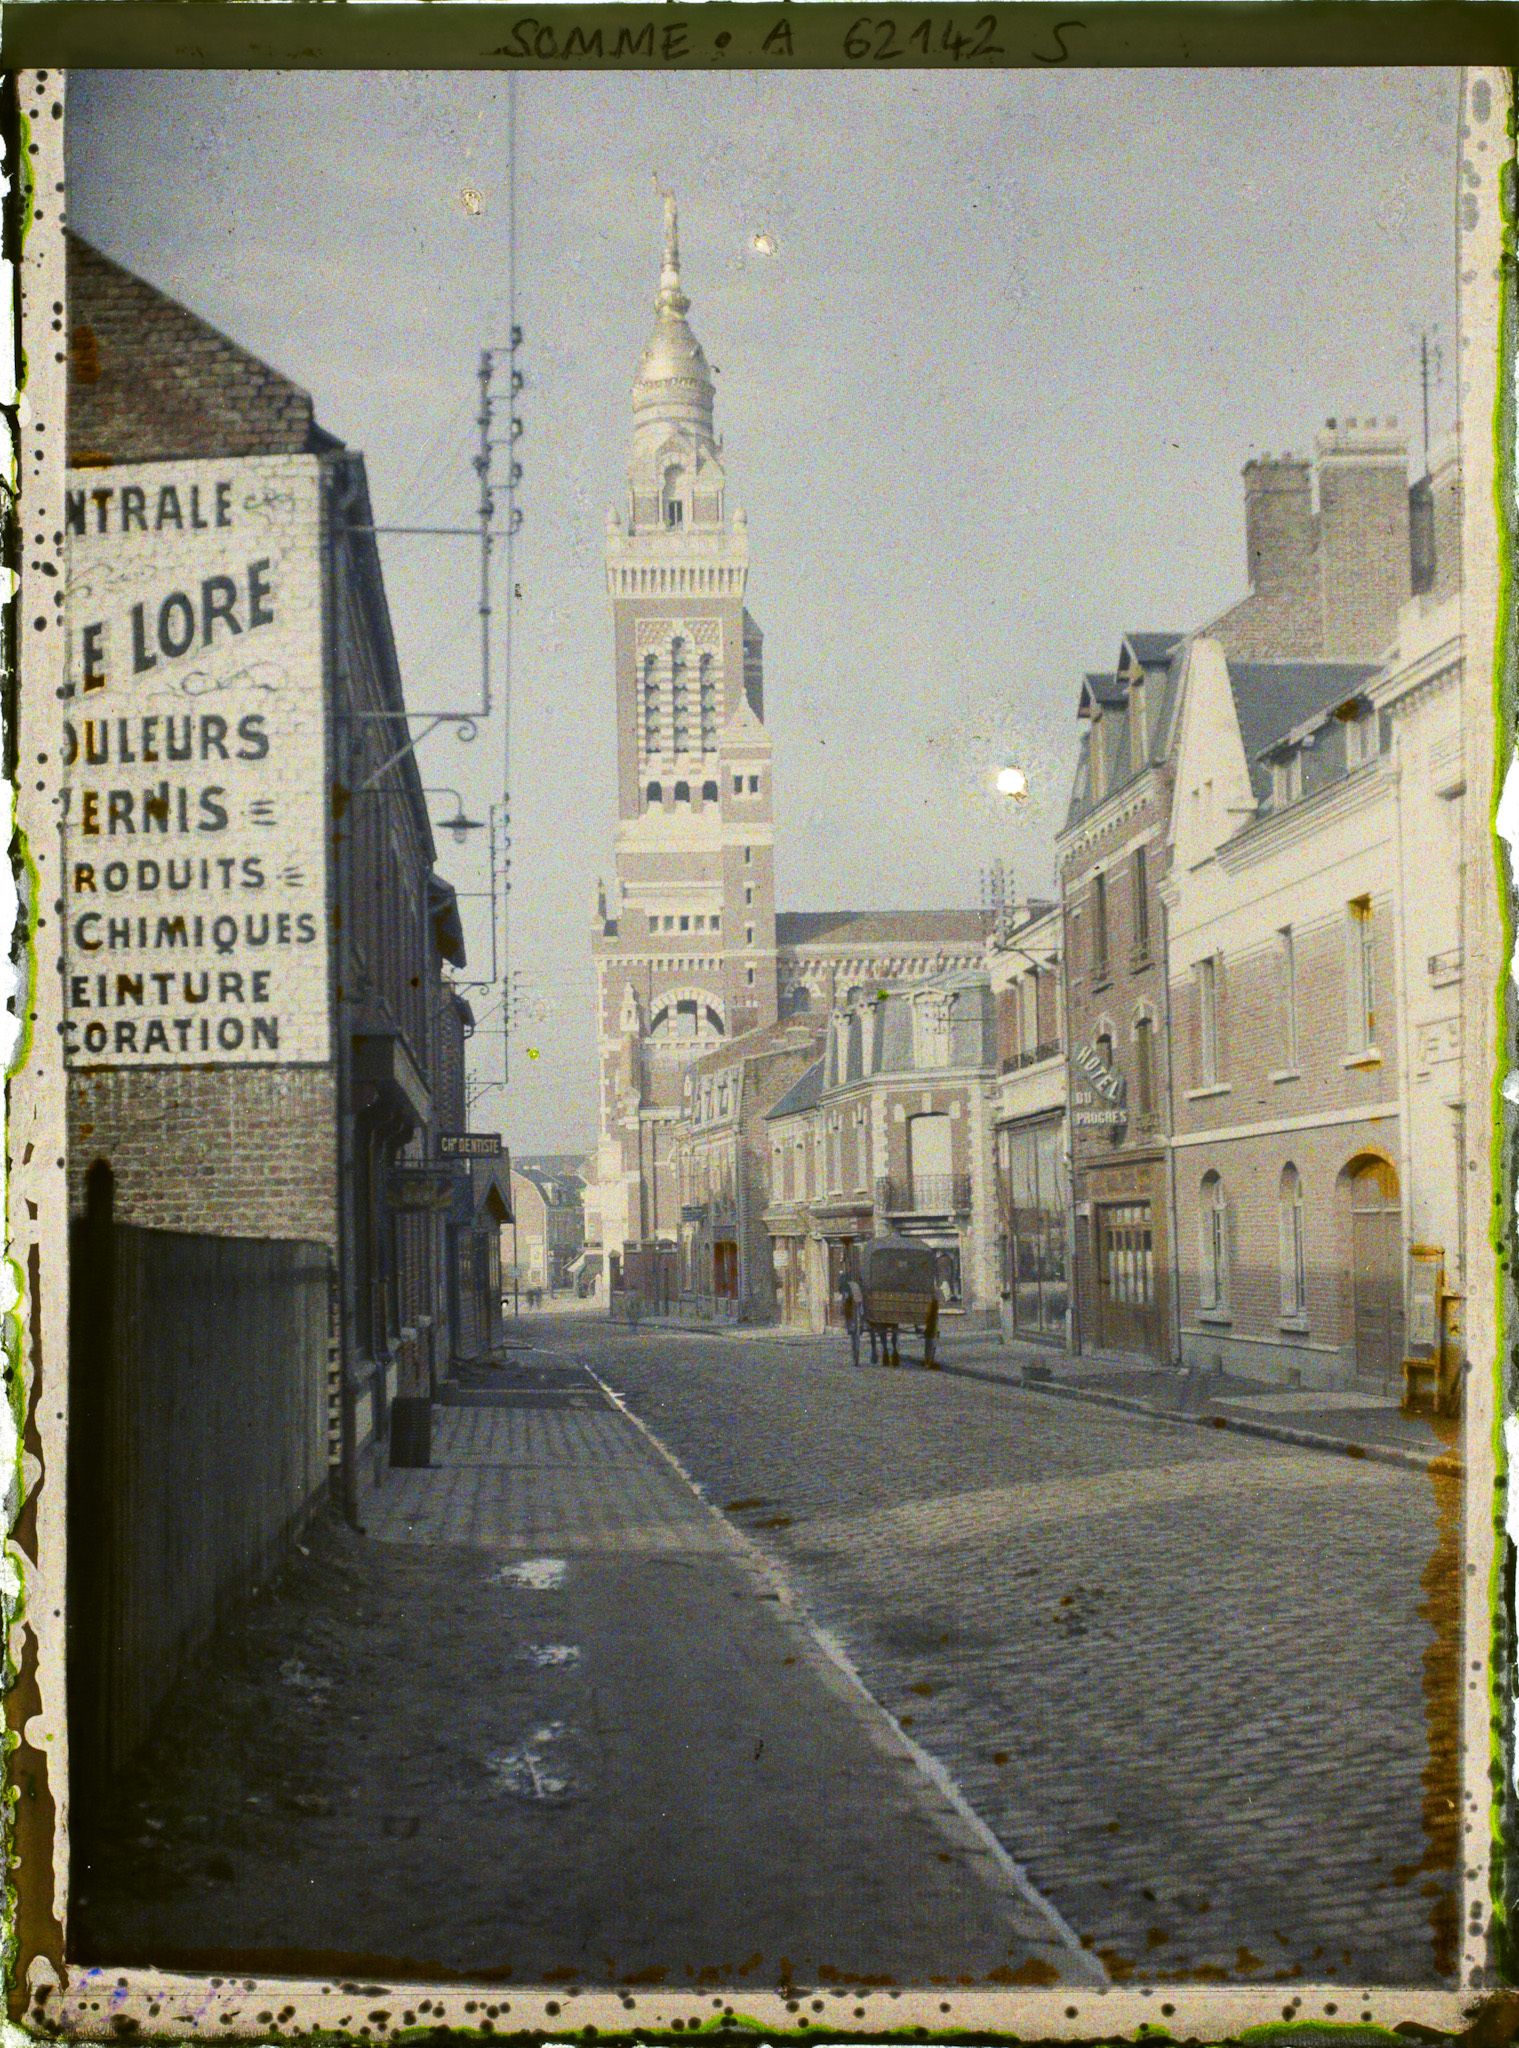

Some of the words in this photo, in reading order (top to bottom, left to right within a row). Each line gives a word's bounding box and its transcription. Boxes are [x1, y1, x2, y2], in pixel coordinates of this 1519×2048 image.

[65, 482, 231, 535] NTRALE
[132, 557, 274, 674] LORE
[74, 857, 265, 893] RODUITS
[74, 911, 316, 954] CHIMIQUES
[71, 970, 271, 1007] EINTURE
[60, 1016, 279, 1054] CORATION
[1077, 1046, 1118, 1099] HOTEL
[1076, 1091, 1092, 1104] DU
[458, 1138, 500, 1154] DENTISTE
